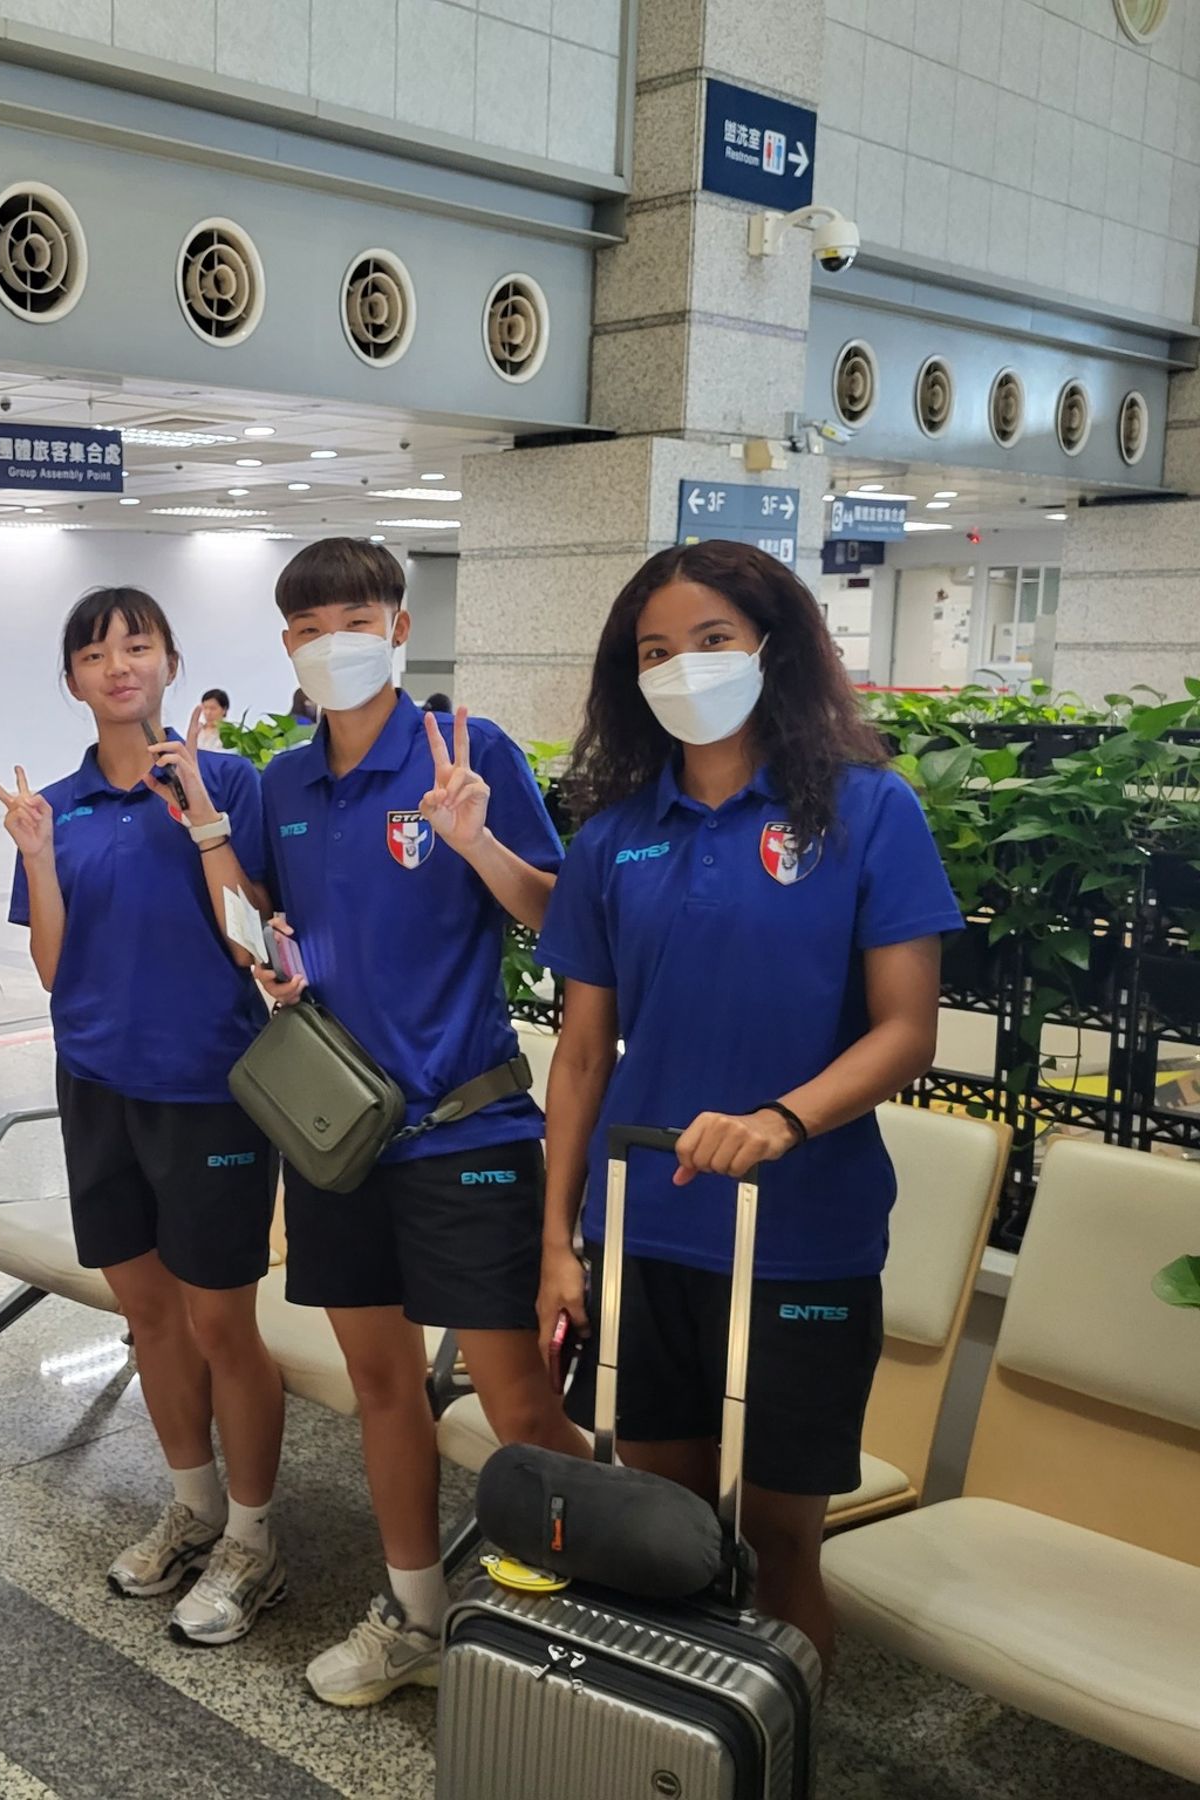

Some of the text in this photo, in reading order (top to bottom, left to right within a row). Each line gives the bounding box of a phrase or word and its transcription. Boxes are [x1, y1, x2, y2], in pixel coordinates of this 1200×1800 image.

[725, 145, 760, 166] Restroom
[8, 466, 111, 482] Group Assembly Point
[707, 491, 726, 513] 3F
[761, 495, 779, 516] 3F
[615, 841, 670, 864] ENTES
[207, 1151, 256, 1168] ENTES
[460, 1170, 517, 1185] ENTES
[779, 1303, 849, 1321] ENTES
